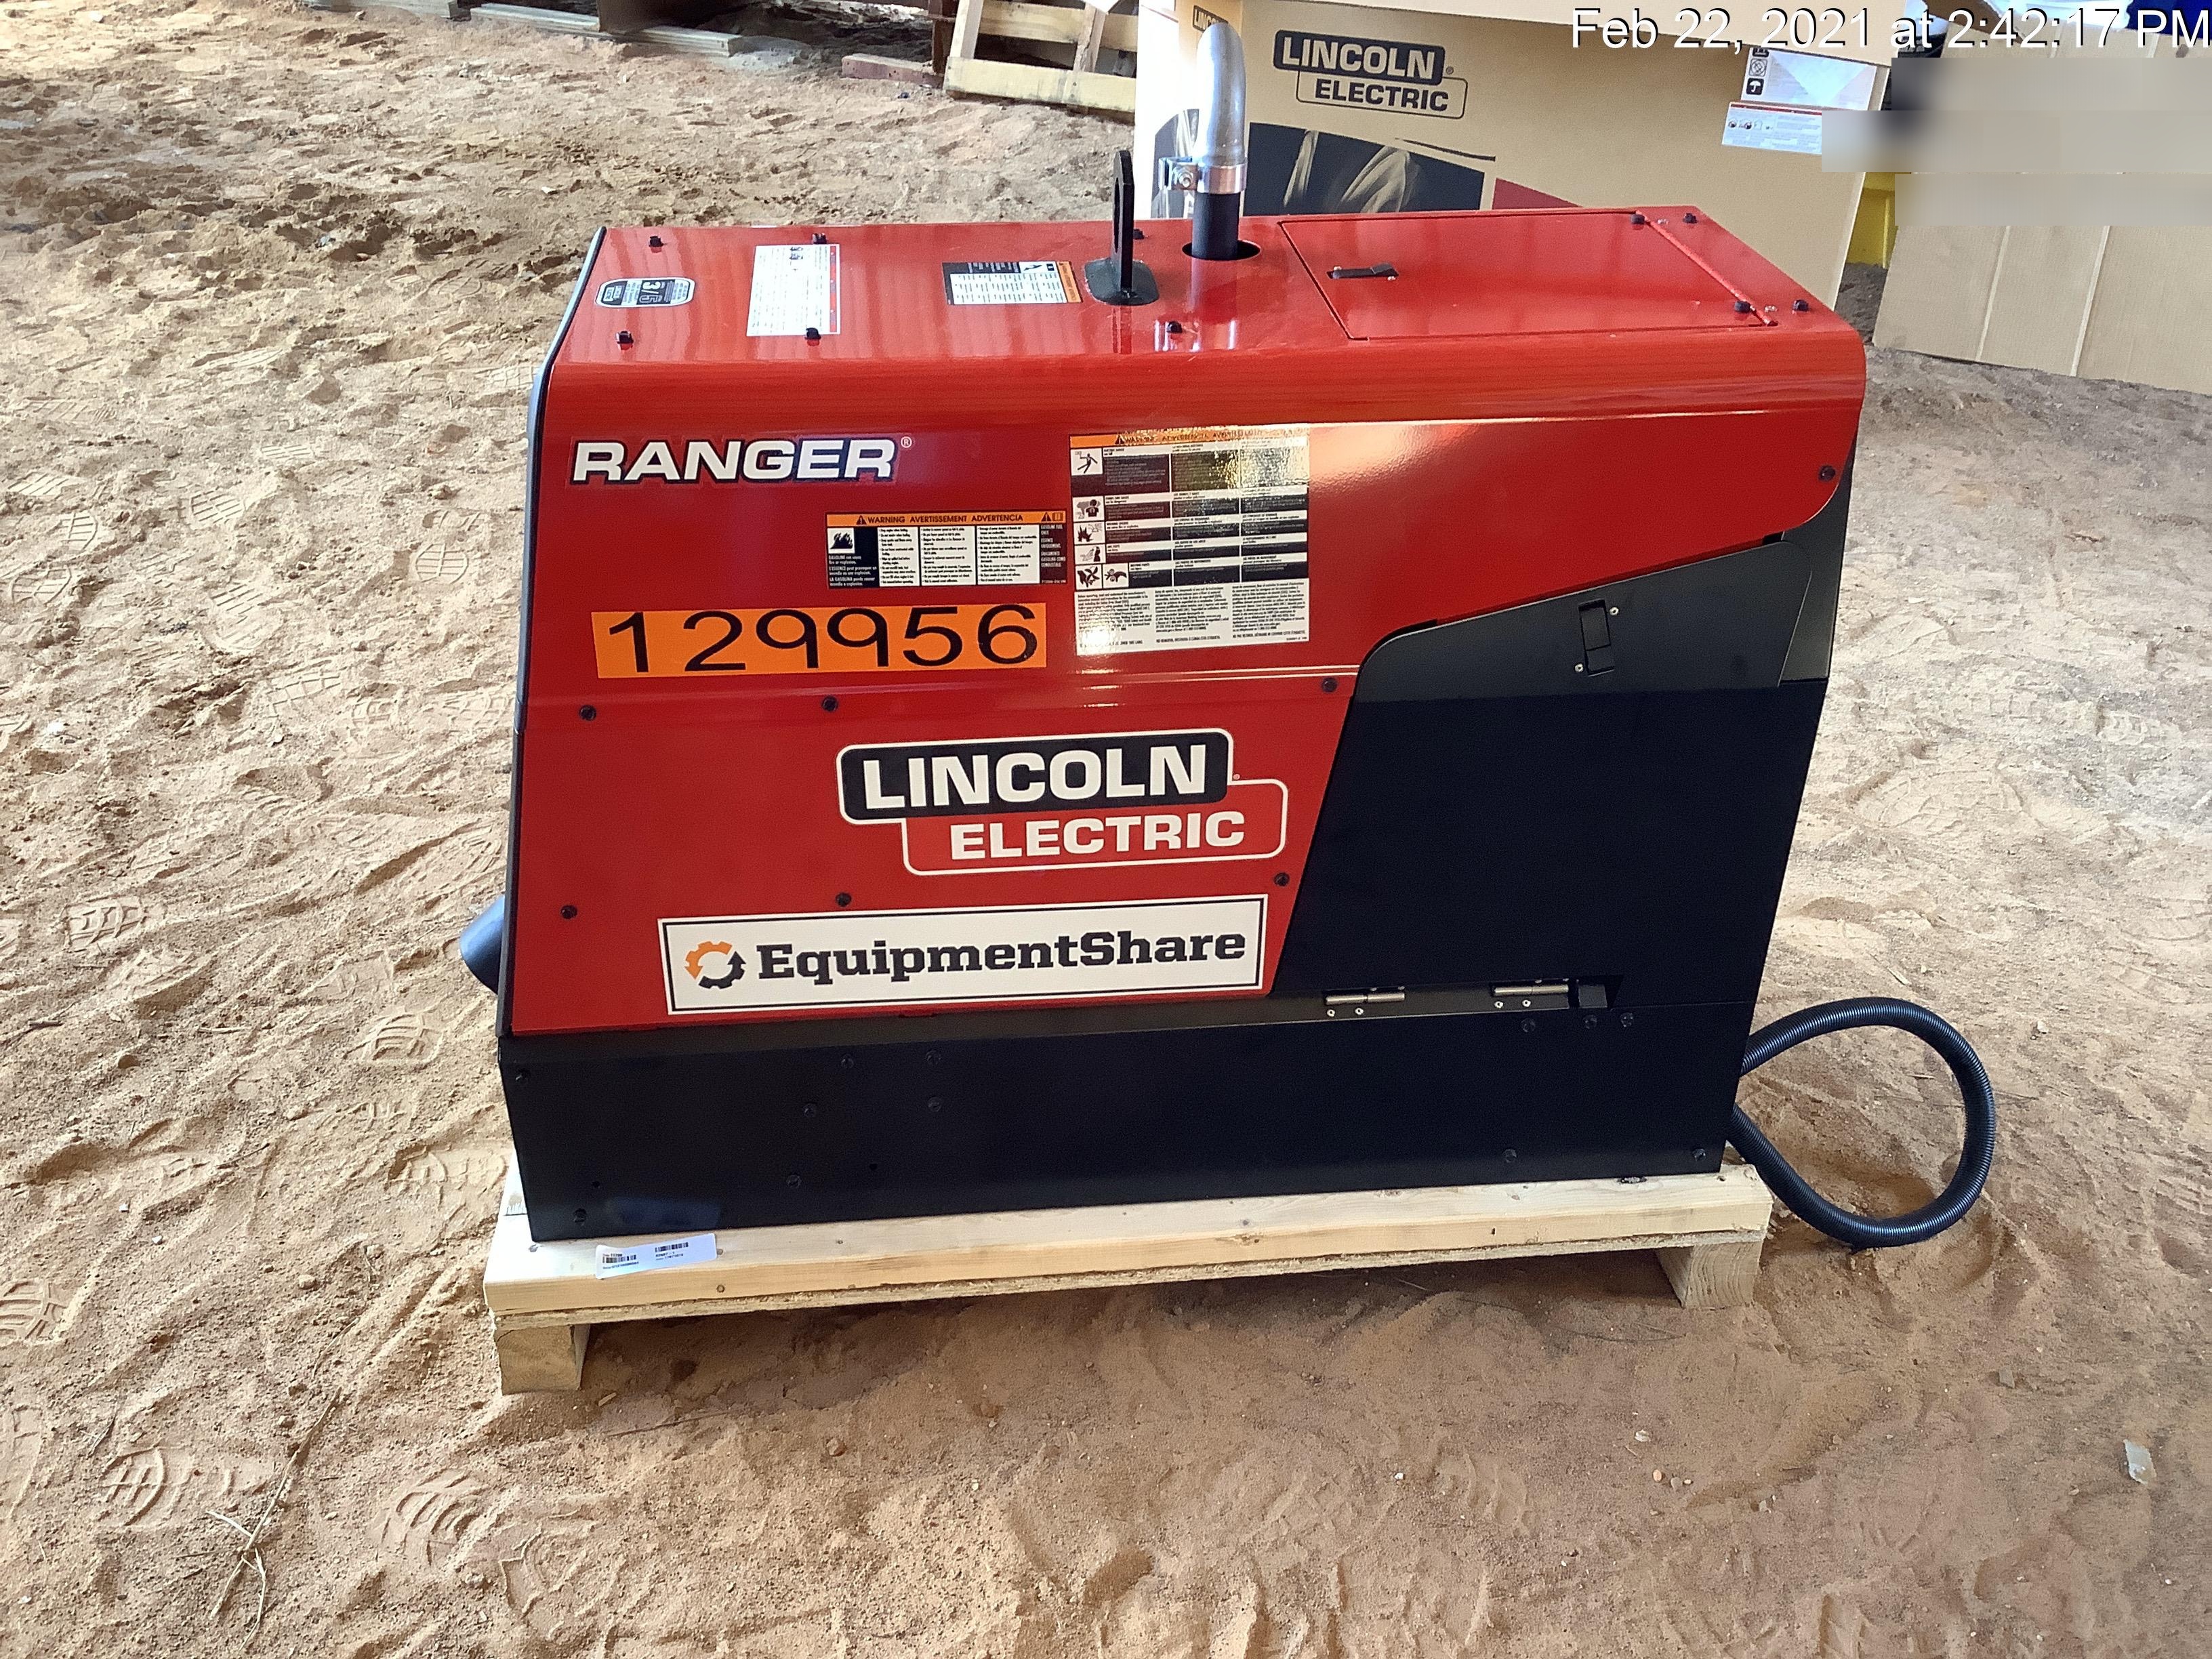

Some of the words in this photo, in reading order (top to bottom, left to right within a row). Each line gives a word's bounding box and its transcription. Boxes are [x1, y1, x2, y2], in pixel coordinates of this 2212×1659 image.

[1282, 37, 1436, 80] LINCOLN
[1315, 78, 1449, 112] ELECTRIC
[909, 515, 967, 523] AVERTISSEMENT
[609, 604, 1038, 674] 129956
[863, 743, 1206, 810] LINCOLN
[949, 811, 1245, 861] ELECTRIC
[756, 930, 1246, 986] EquipmentShare
